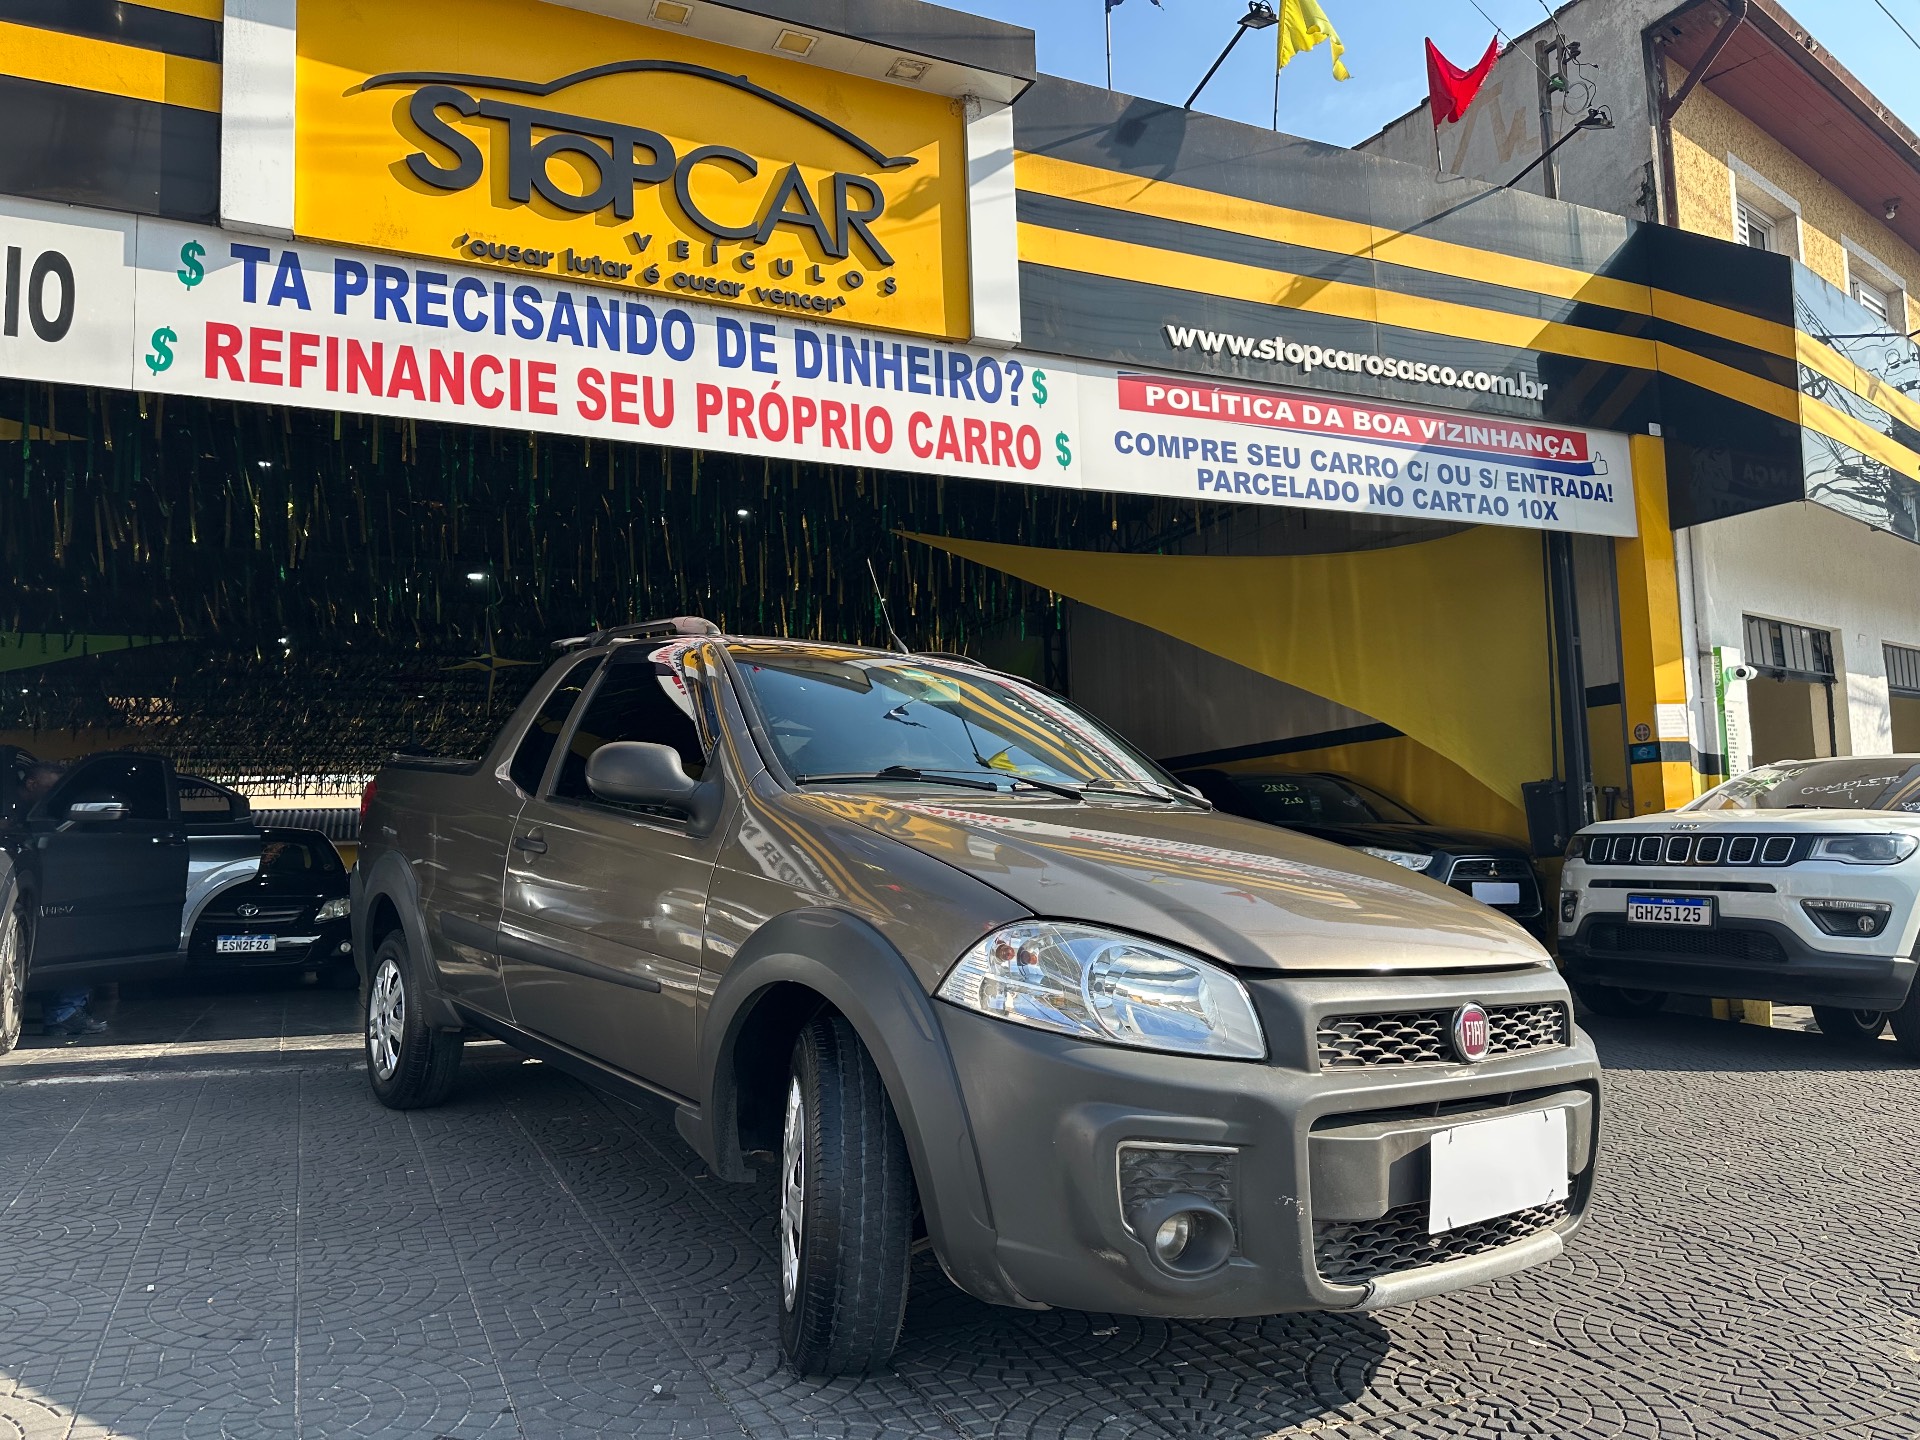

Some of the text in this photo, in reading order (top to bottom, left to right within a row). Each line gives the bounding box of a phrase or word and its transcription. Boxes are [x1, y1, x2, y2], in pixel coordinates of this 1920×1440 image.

[567, 247, 633, 279] lutar
[644, 263, 661, 284] é
[673, 271, 746, 298] ousar
[633, 231, 897, 295] VEÍCULOS
[230, 243, 311, 311] TA
[333, 259, 695, 362] PRECISANDO
[716, 317, 778, 374] DE
[794, 328, 1024, 407] DINHEIRO?
[1165, 325, 1549, 401] www.stopcarosasco.com.br
[204, 321, 559, 416] REFINANCIE
[577, 367, 675, 429] SEU
[696, 380, 894, 455] PRÓPRIO
[907, 411, 1042, 471] CARRO
[1145, 386, 1578, 458] POLÍTICA DA BOA VIZINHANÇA
[1114, 430, 1614, 503] COMPRE SEU CARRO C/ OU S/ ENTRADA!
[1197, 468, 1560, 522] PARCELADO NO CARTAO 10X
[1801, 775, 1902, 795] COMPLETO
[1635, 905, 1701, 923] GHZ5I25
[222, 940, 269, 951] ESN2F26
[1464, 1020, 1484, 1047] FIAT
